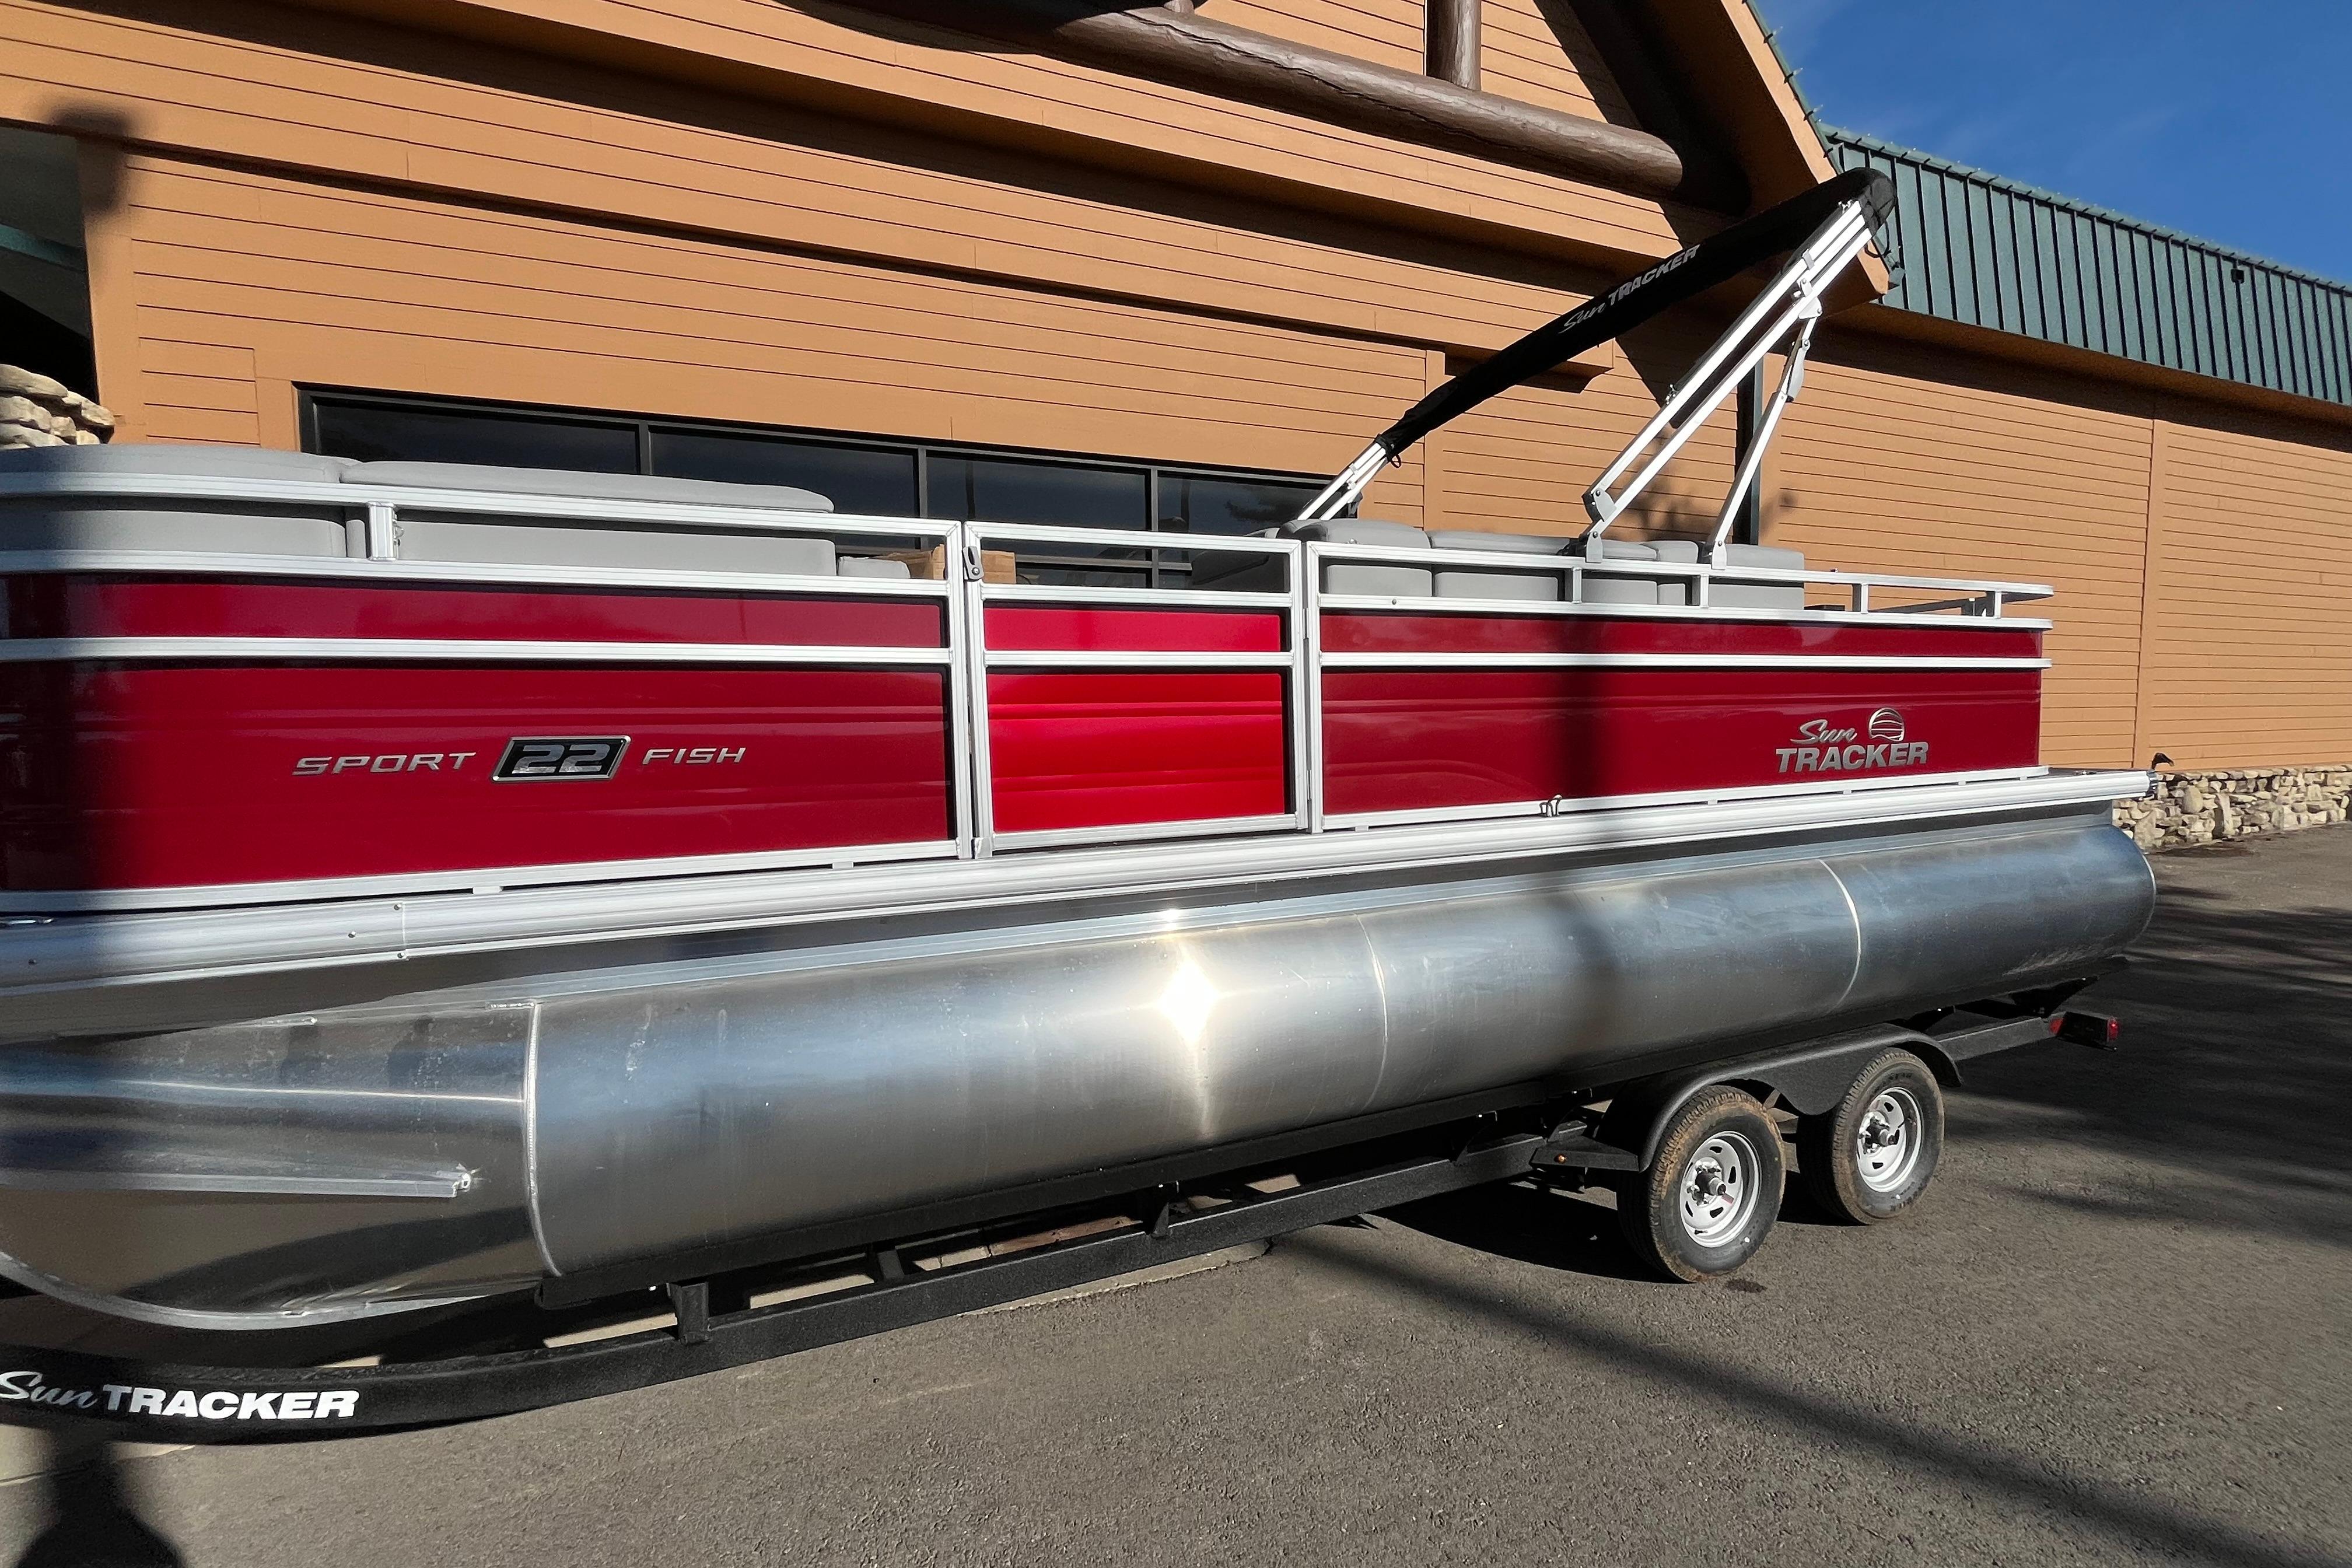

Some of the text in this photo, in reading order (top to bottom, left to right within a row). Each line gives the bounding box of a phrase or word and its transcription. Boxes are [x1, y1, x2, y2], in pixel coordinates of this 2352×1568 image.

[1558, 244, 1700, 334] Sun TRACKER
[1790, 719, 1857, 744] Sun
[293, 744, 747, 776] SPORT 22 FISH
[1776, 741, 1929, 773] TRACKER
[0, 1371, 359, 1420] Sun TRACKER
